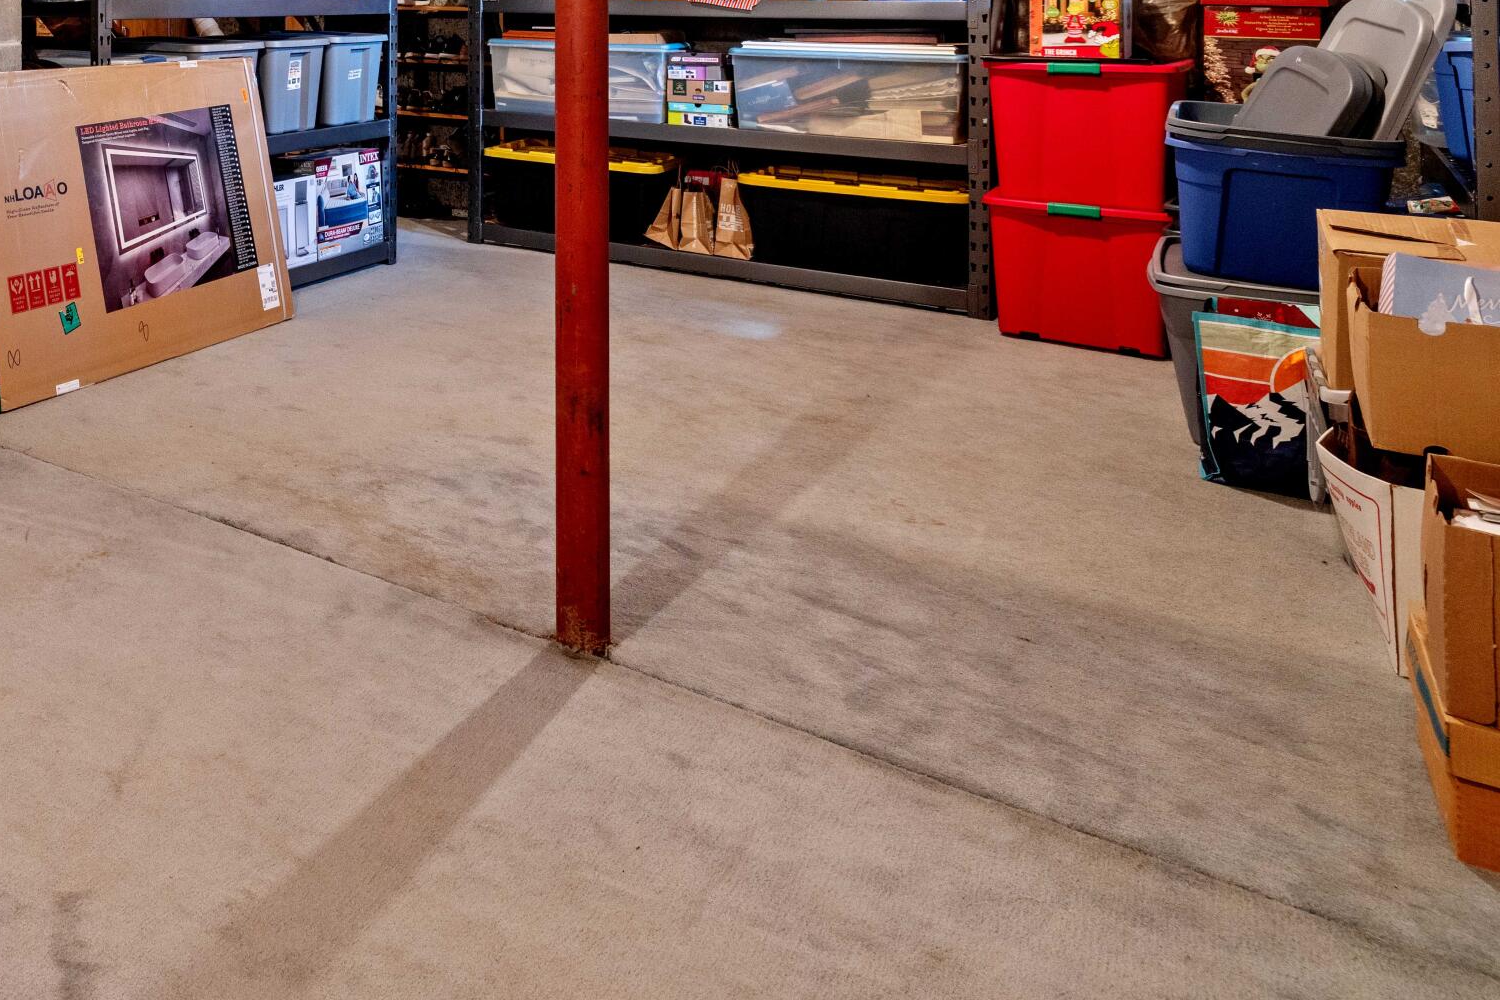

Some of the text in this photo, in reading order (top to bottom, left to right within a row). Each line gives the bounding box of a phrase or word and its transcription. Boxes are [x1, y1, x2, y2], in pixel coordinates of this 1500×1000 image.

[1044, 48, 1056, 56] THE
[80, 126, 95, 136] LED
[95, 123, 118, 133] Lighted
[119, 119, 148, 130] Bathroom
[359, 151, 380, 164] INTEX
[315, 164, 328, 172] QUEEN
[324, 227, 347, 238] DURA-BEAM
[347, 224, 360, 233] DELUXE
